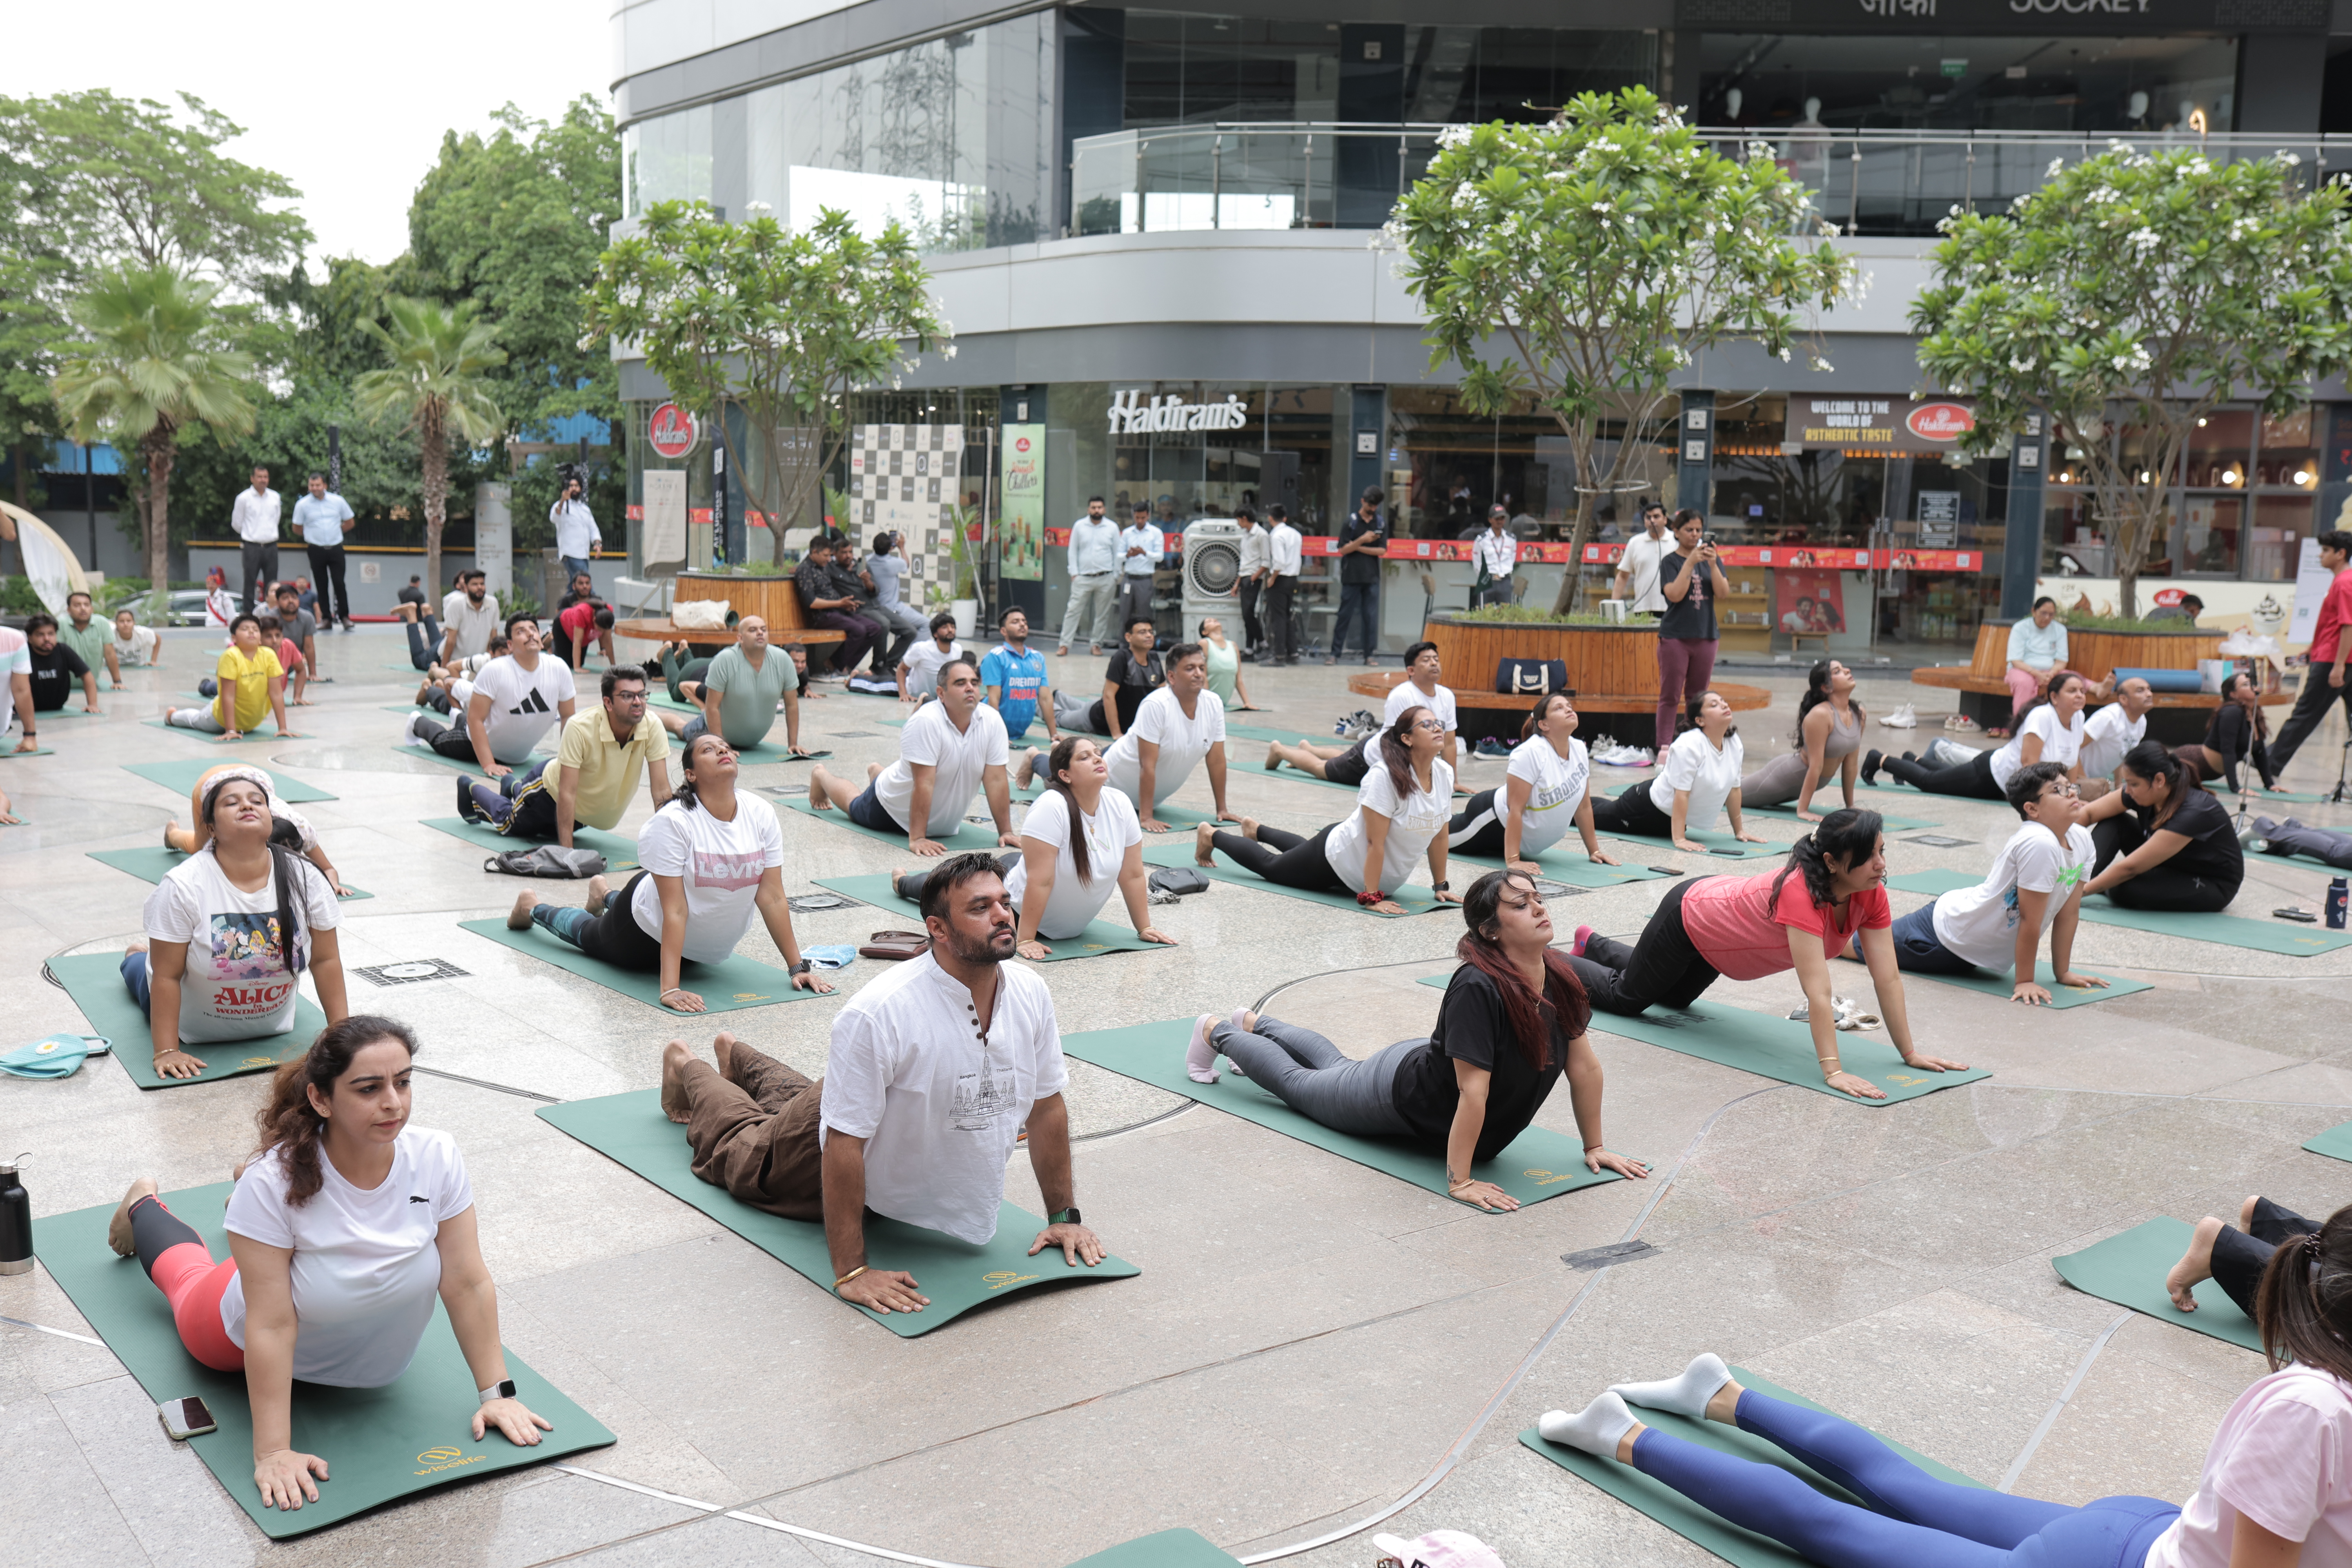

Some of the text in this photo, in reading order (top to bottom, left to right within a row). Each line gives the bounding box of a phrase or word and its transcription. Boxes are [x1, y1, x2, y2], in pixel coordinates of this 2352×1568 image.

[1107, 389, 1248, 434] Haldiram's
[1811, 401, 1890, 414] WELCOME TO THE
[1826, 414, 1873, 427] WORLD OF
[1805, 428, 1893, 442] AUTHENTIC TASTE
[1009, 688, 1037, 700] INDIA
[1534, 1174, 1574, 1185] wiselife
[988, 1275, 1040, 1289] wiselife
[414, 1455, 487, 1475] wiselife
